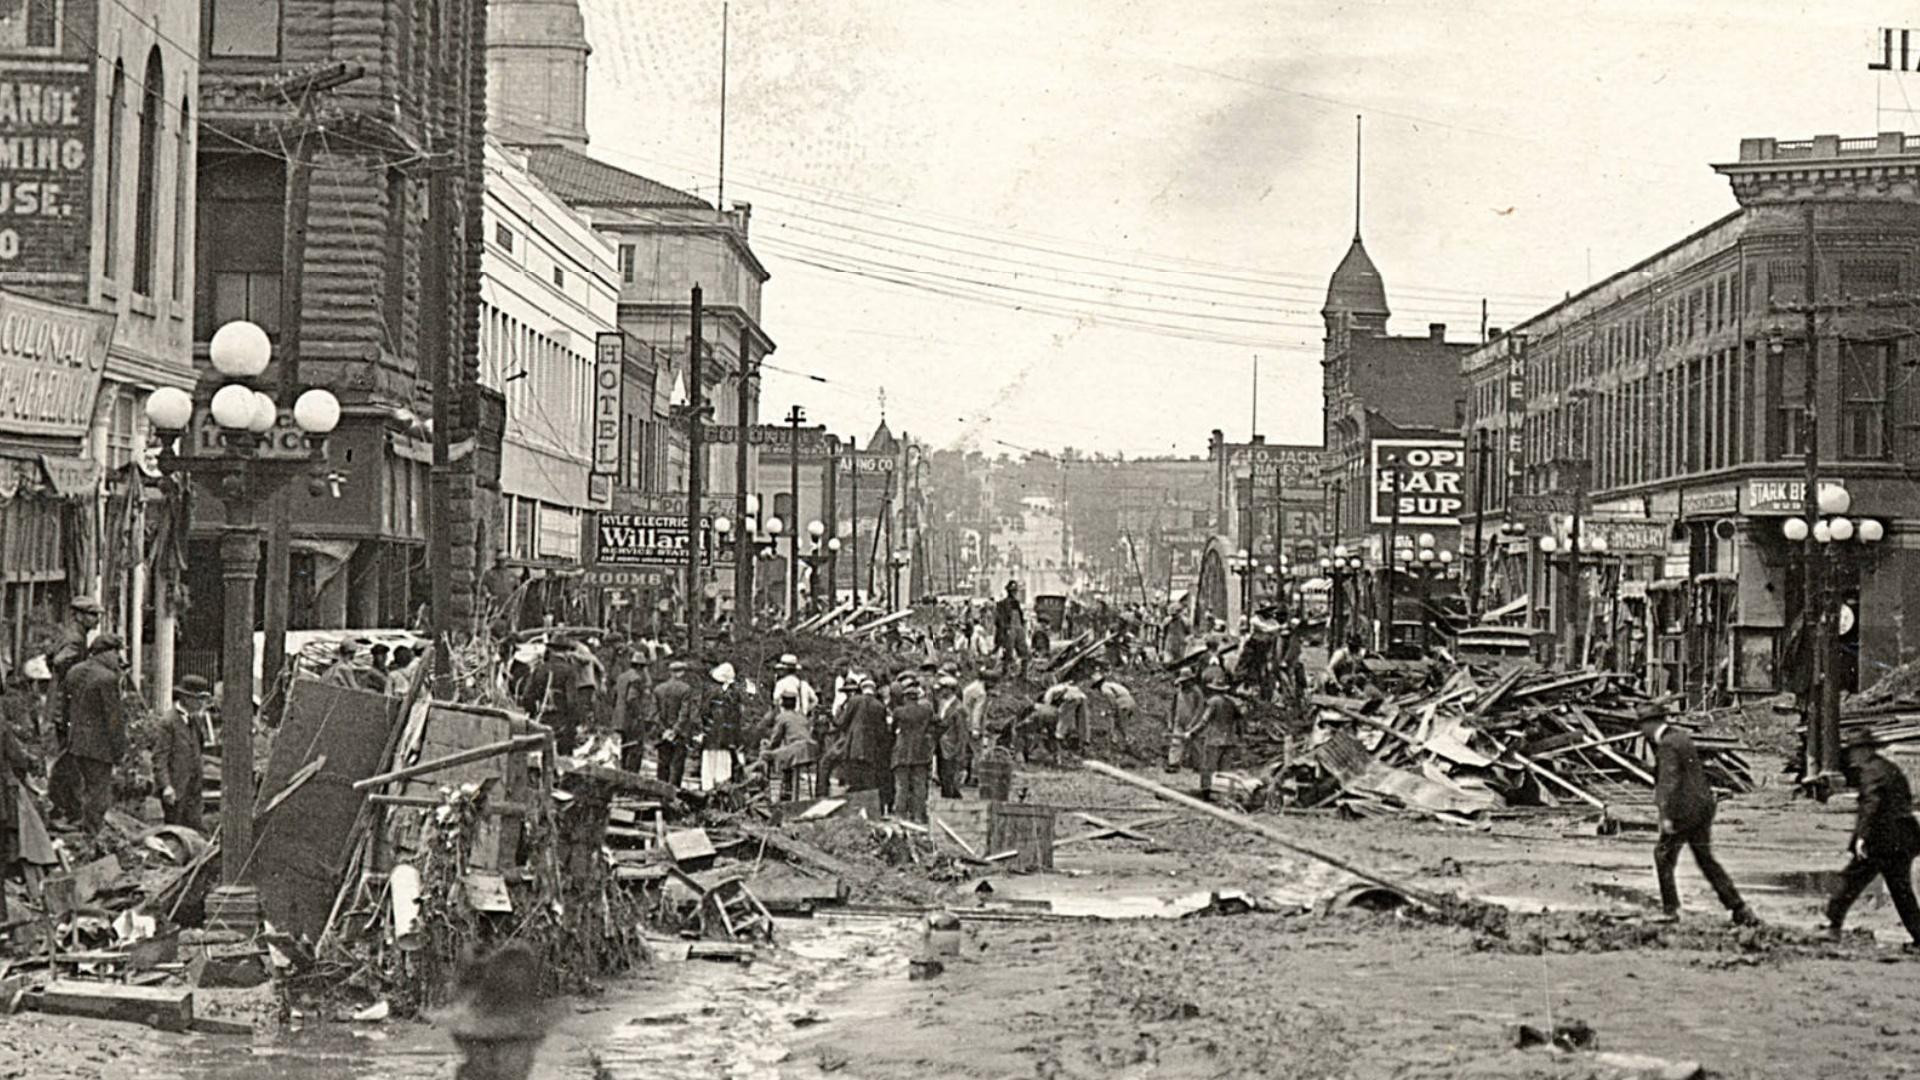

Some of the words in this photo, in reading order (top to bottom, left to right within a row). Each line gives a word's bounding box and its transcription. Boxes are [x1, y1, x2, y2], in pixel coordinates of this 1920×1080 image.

[1509, 337, 1525, 399] THE
[598, 343, 619, 465] HOTEL
[877, 459, 893, 470] CO
[1750, 483, 1787, 507] STARK
[1399, 497, 1462, 515] SUP
[602, 515, 631, 526] KYLE
[633, 516, 689, 528] ELECTRIC
[601, 546, 653, 556] SERVICE
[656, 549, 707, 557] STATIN
[583, 572, 662, 586] ROOMS
